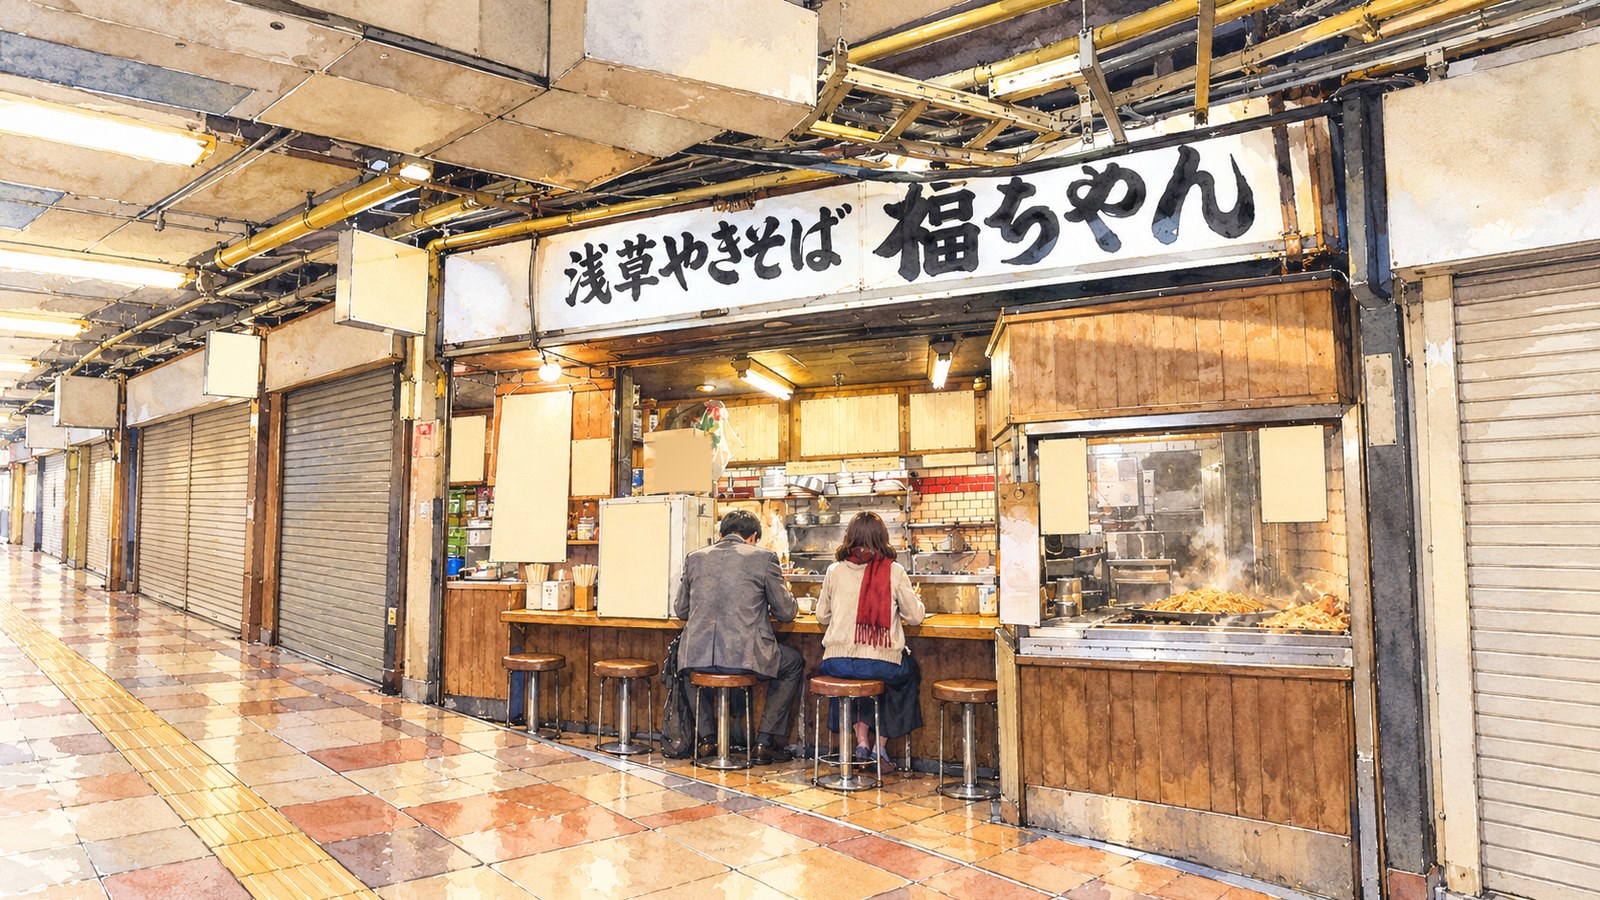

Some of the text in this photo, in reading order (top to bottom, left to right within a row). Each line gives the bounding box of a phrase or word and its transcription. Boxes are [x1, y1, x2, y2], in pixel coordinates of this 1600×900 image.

[564, 203, 853, 308] 浅草やきそば
